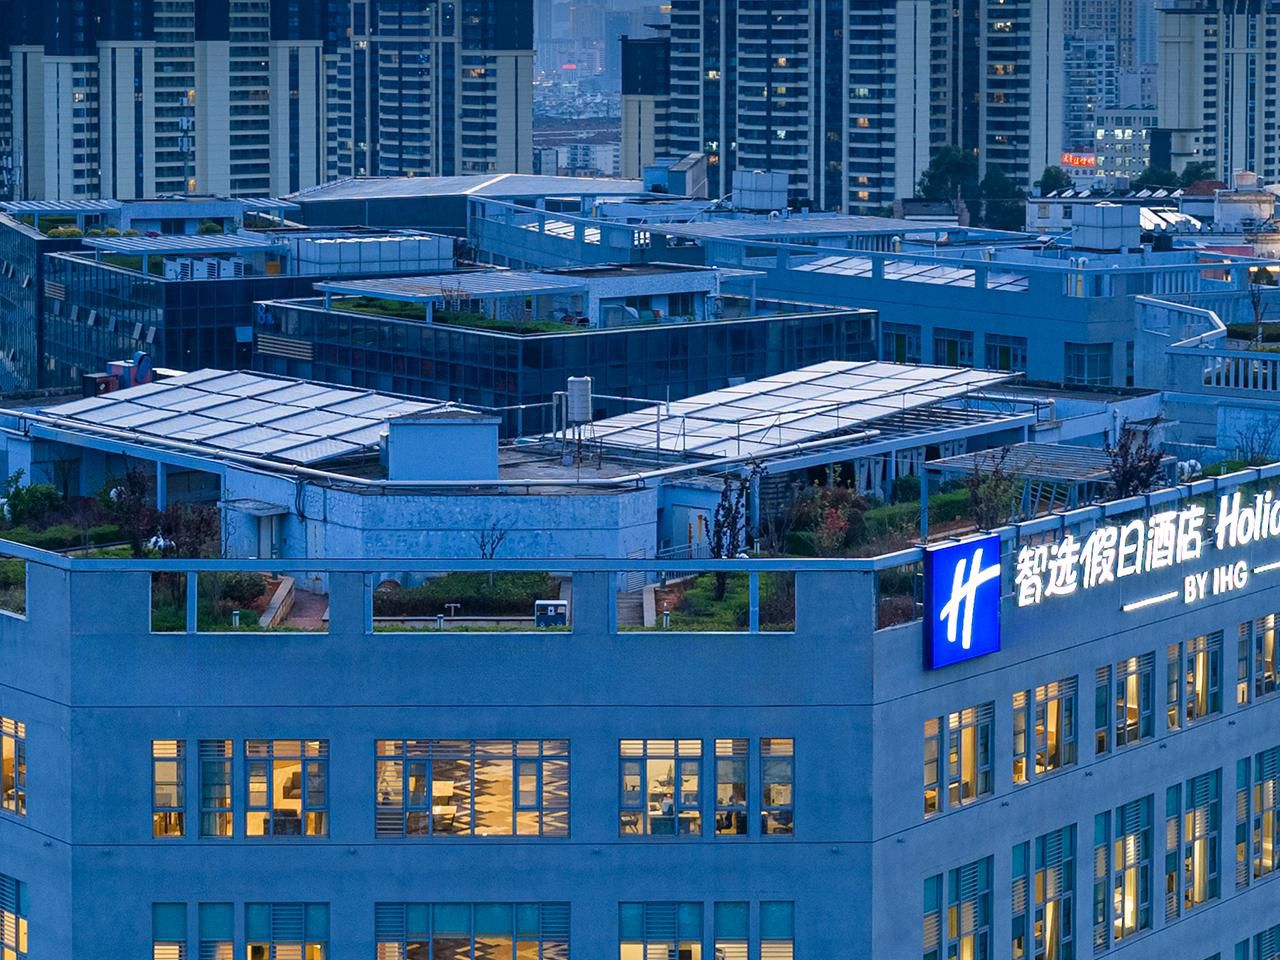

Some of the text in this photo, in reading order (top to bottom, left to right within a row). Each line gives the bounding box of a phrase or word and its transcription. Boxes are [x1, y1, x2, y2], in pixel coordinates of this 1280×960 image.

[1015, 504, 1205, 607] 智选假日酒店
[1184, 560, 1248, 604] BY IHG
